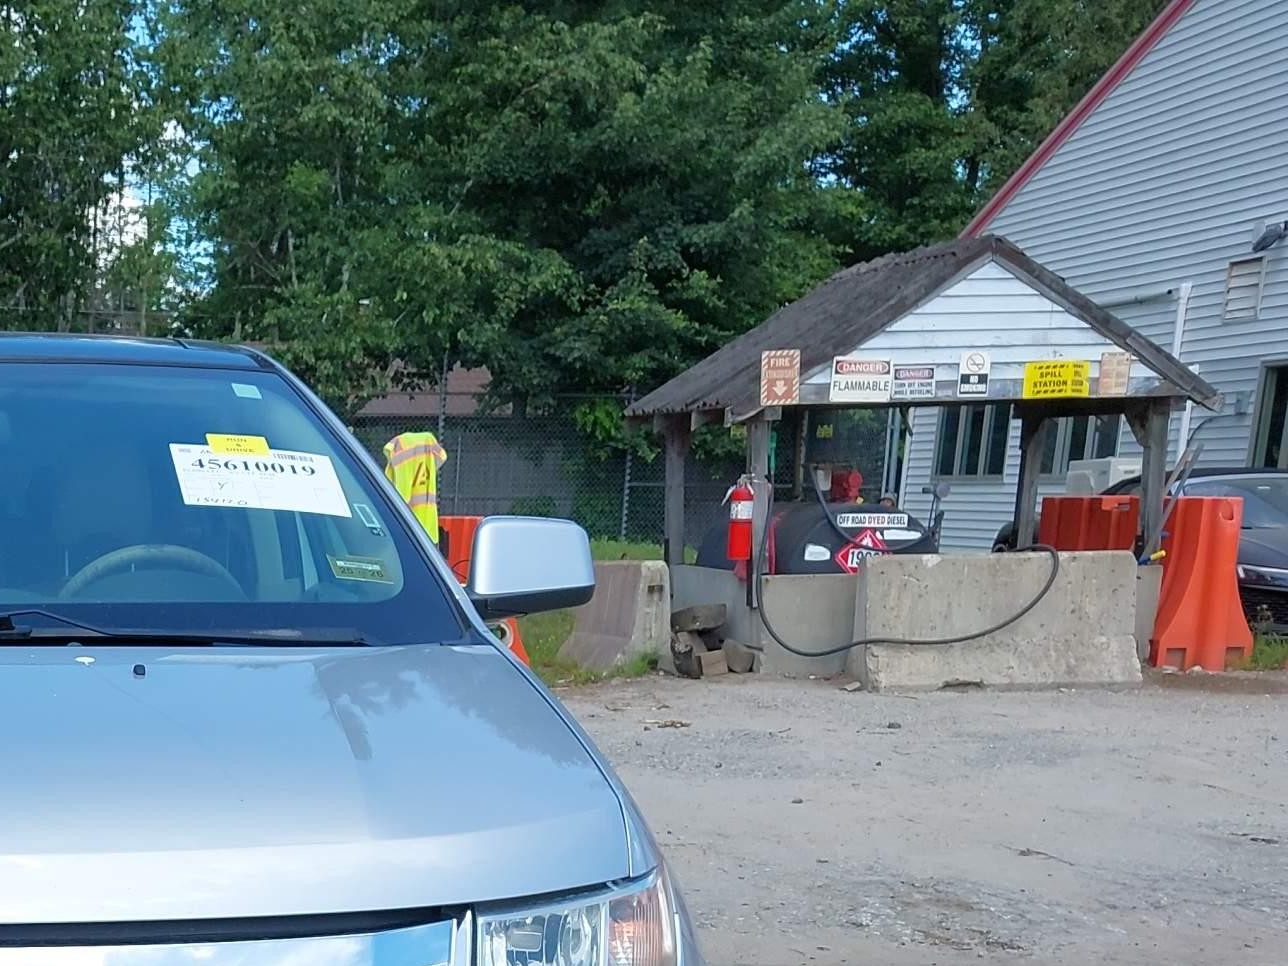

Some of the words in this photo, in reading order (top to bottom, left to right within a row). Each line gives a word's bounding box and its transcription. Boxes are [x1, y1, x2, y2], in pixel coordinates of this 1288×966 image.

[770, 357, 791, 368] FIRE
[842, 361, 883, 373] DANGER
[1039, 370, 1062, 378] SPILL
[833, 380, 890, 392] FLAMMABLE
[1032, 380, 1068, 388] STATION
[191, 458, 316, 476] 45610019
[839, 516, 850, 525] OFF
[851, 516, 866, 525] ROAD
[868, 515, 885, 525] DYED
[887, 514, 906, 525] DIESEL
